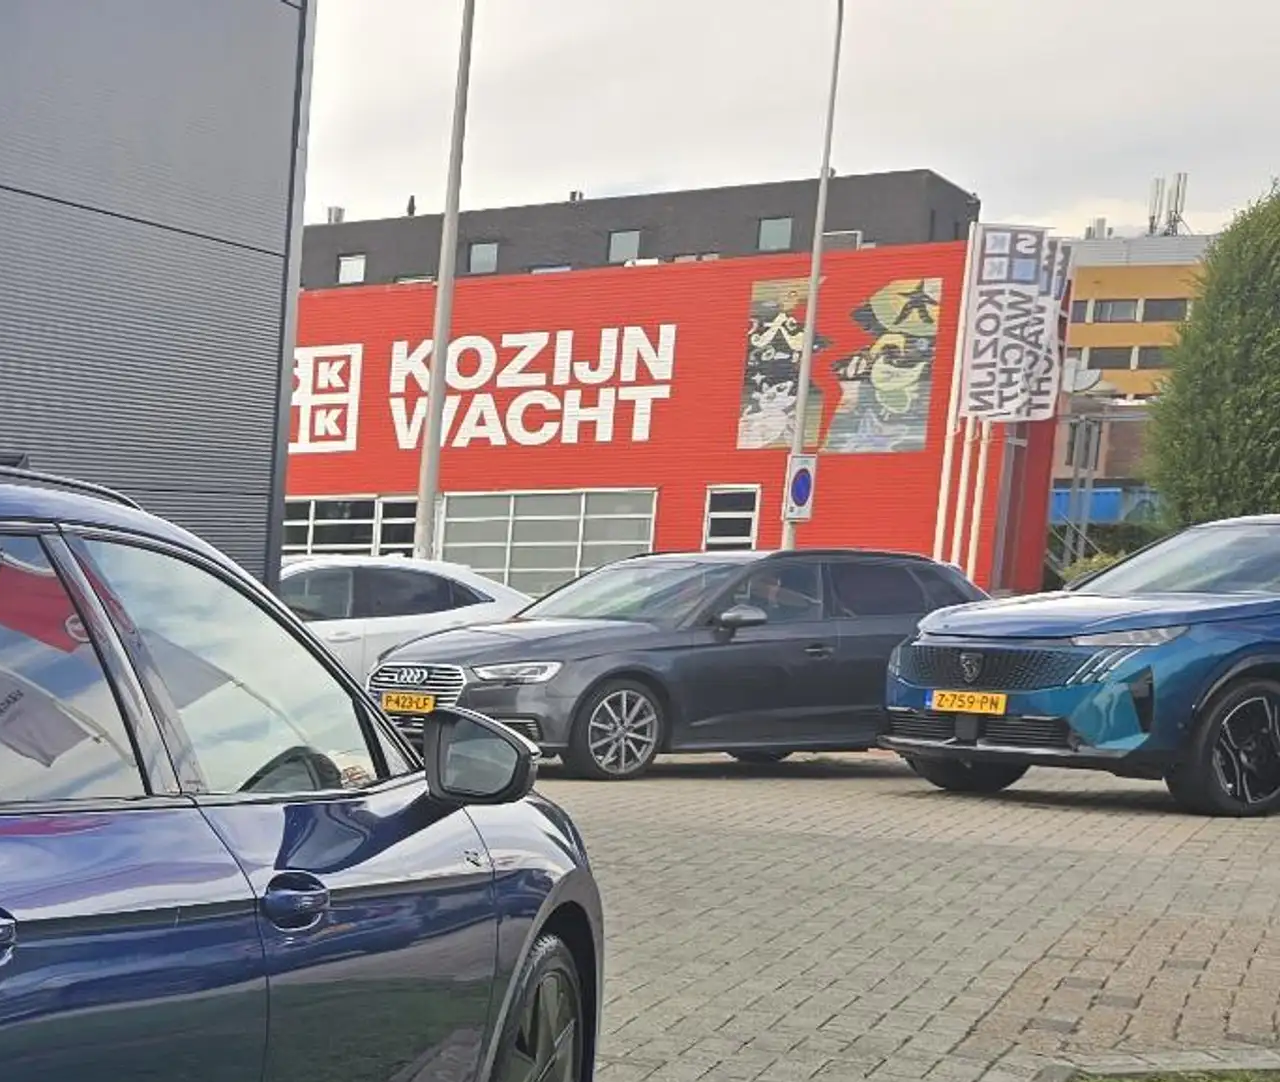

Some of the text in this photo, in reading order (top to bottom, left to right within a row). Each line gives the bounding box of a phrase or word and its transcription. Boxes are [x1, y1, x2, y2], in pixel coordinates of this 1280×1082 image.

[389, 324, 677, 393] KOZIJN
[388, 385, 671, 449] WACHT
[936, 693, 1000, 711] Z-759-PN
